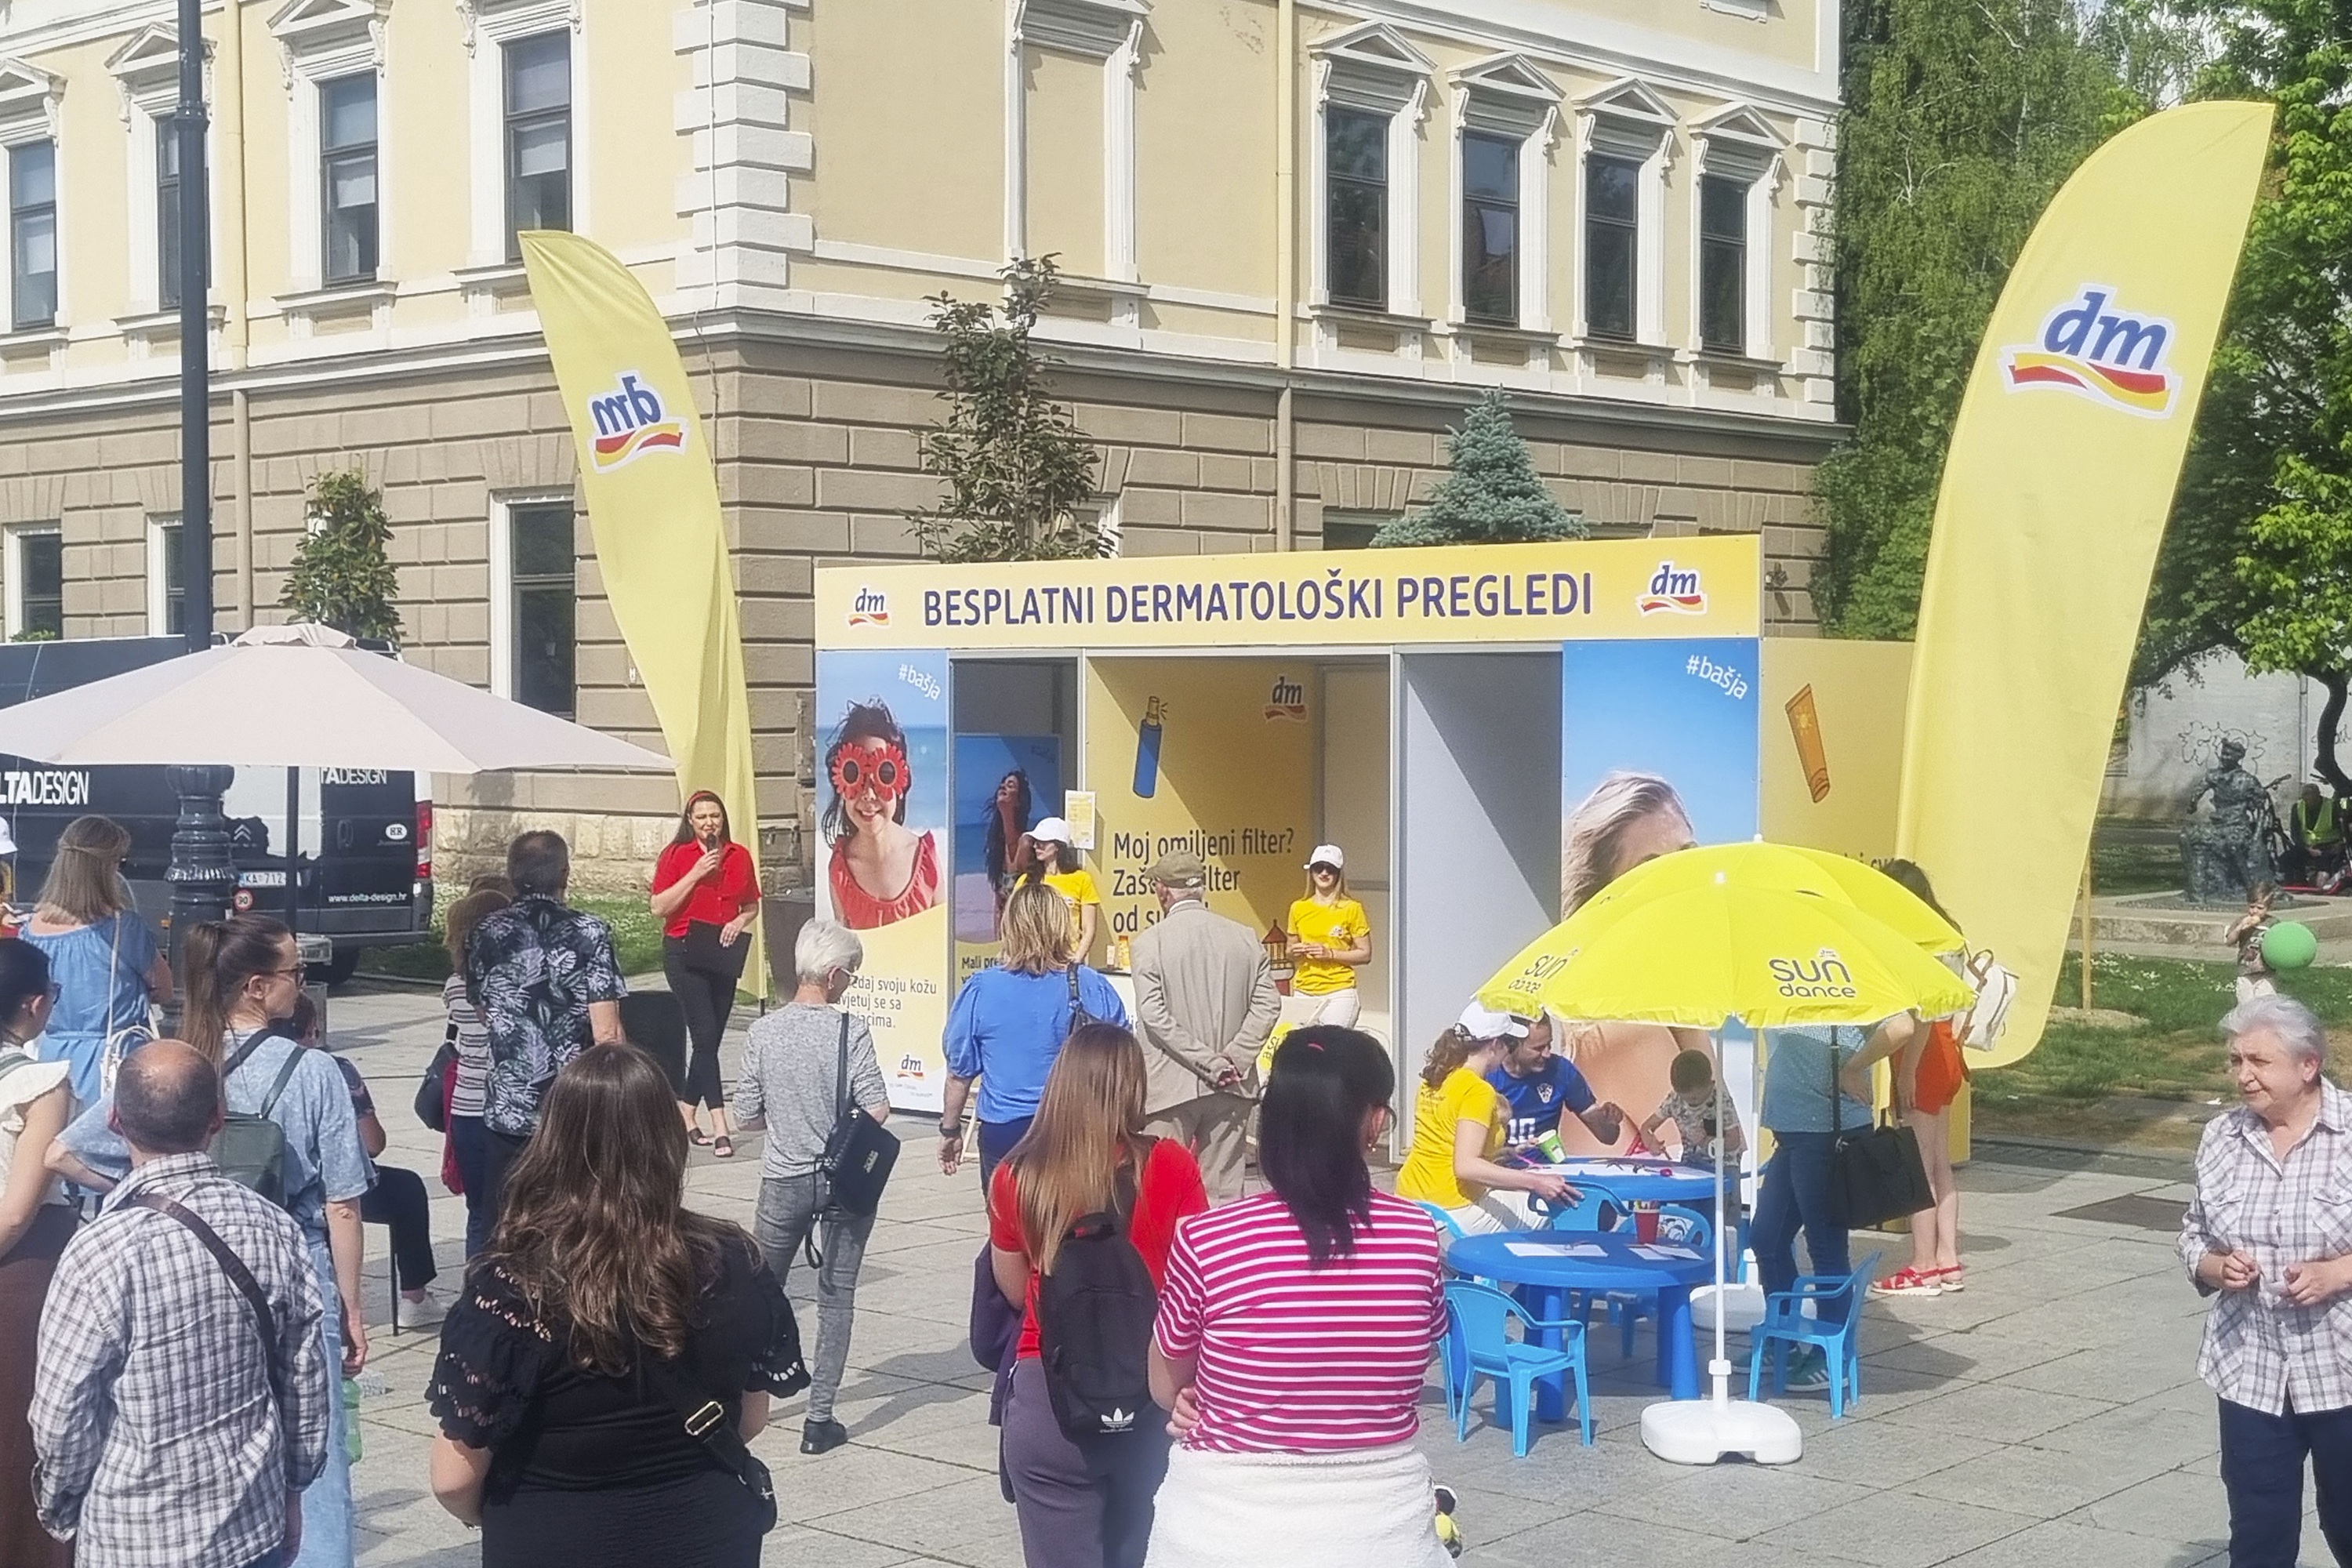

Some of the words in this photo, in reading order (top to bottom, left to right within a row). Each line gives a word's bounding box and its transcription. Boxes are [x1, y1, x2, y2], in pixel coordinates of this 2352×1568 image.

[2044, 292, 2167, 370] dm
[1651, 564, 1697, 595] dm
[855, 588, 885, 612] dm
[924, 586, 1094, 626] BESPLATNI
[1106, 568, 1381, 623] DERMATOLOŠKI
[1397, 572, 1591, 618] PREGLEDI
[898, 663, 941, 701] #bašja
[1272, 676, 1302, 704] dm
[1686, 655, 1748, 699] #bašja
[390, 827, 404, 836] HR
[1113, 831, 1150, 865] Moj
[1157, 829, 1236, 863] omiljeni
[1241, 827, 1294, 855] filter?
[1203, 865, 1240, 892] ilter
[1112, 904, 1138, 934] od
[1769, 958, 1851, 983] sun
[878, 977, 906, 995] svoju
[909, 978, 937, 994] kožu
[1779, 983, 1856, 998] dance
[874, 997, 886, 1009] se
[889, 998, 902, 1011] sa
[902, 1054, 921, 1072] dm
